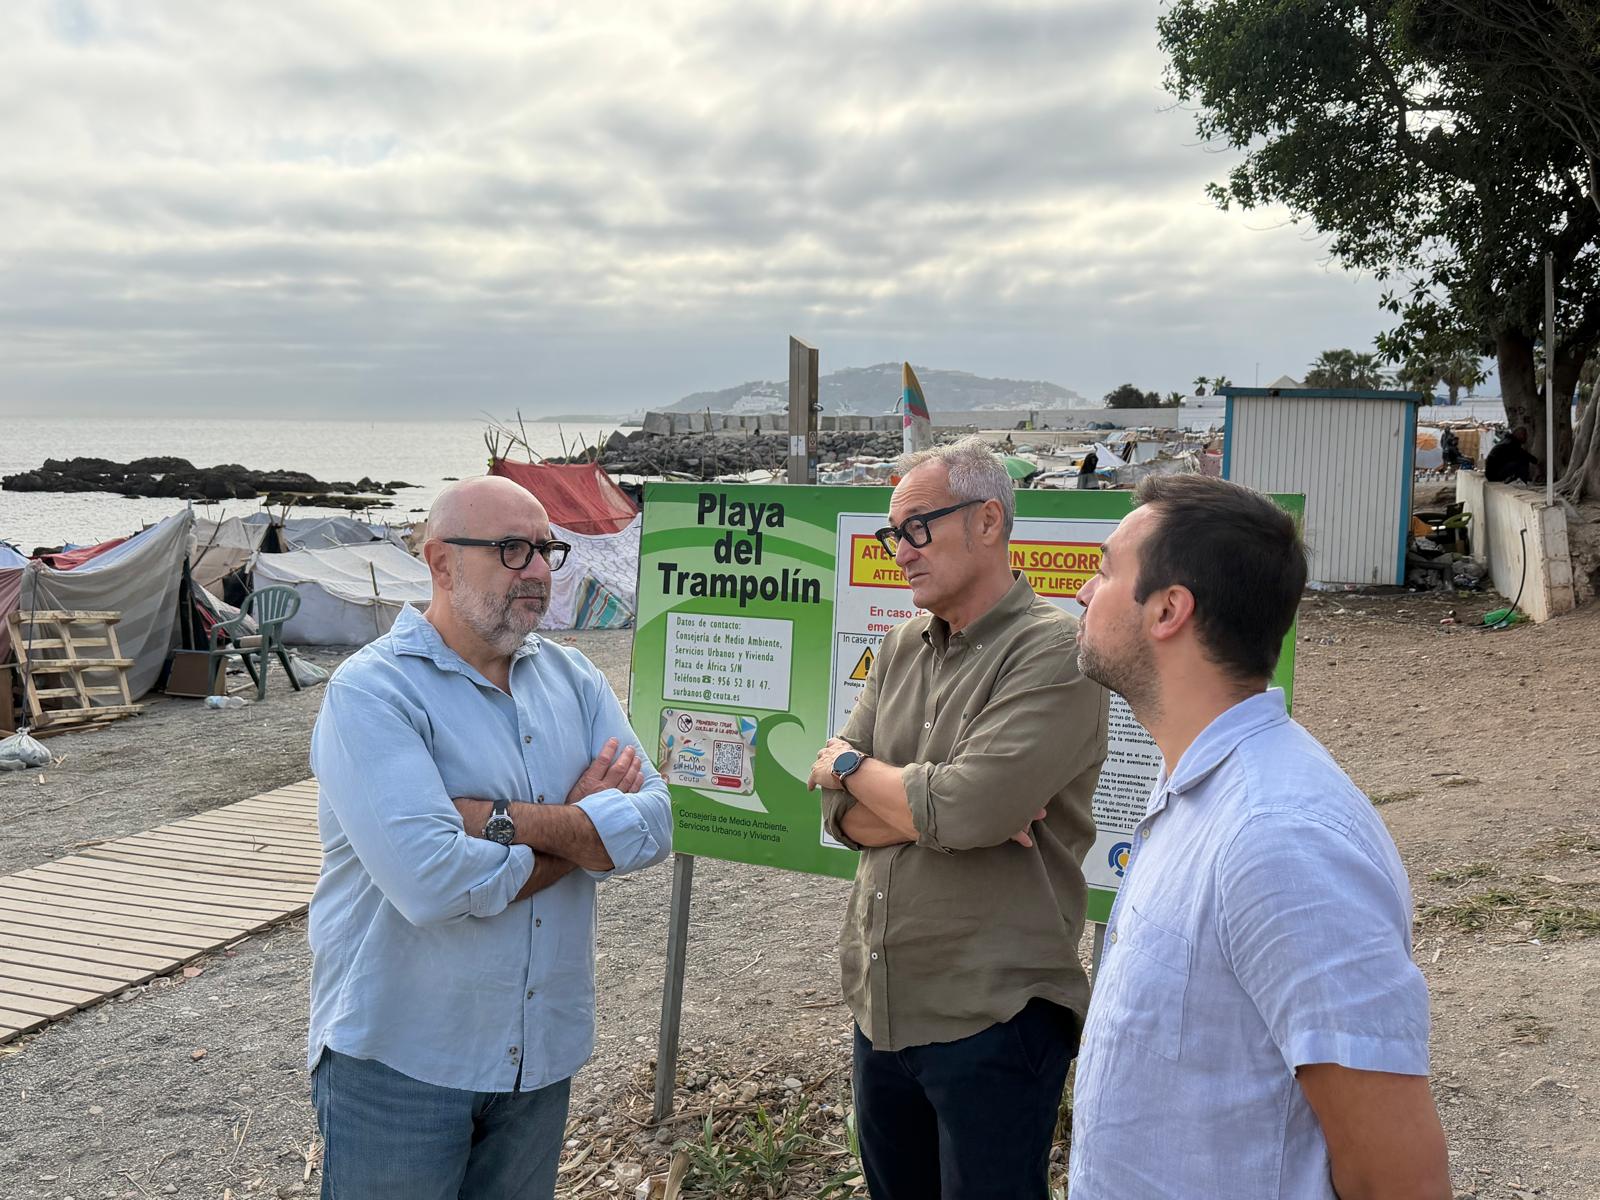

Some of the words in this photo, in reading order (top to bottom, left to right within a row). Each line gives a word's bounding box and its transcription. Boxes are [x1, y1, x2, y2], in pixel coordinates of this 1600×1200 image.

[697, 492, 785, 535] Playa
[714, 530, 763, 565] del
[1030, 551, 1102, 569] SOCORR
[657, 562, 821, 608] Trampolín
[870, 606, 884, 617] En
[886, 609, 912, 619] caso
[676, 616, 695, 627] Datos
[698, 617, 706, 627] de
[713, 633, 721, 643] de
[724, 634, 745, 645] Medio
[843, 635, 850, 643] In
[851, 637, 868, 645] case
[869, 637, 877, 645] of
[675, 645, 704, 656] Servicios
[707, 647, 735, 659] Urbanos
[738, 652, 743, 662] y
[745, 651, 775, 662] Vivienda
[674, 658, 692, 669] Plaza
[695, 660, 704, 670] de
[717, 676, 731, 687] 956
[734, 677, 743, 688] 52
[679, 754, 700, 763] PLAYA
[678, 774, 700, 783] Ceuta
[718, 815, 728, 824] de
[729, 816, 751, 827] Medio
[678, 820, 710, 832] Servicios
[711, 825, 742, 837] Urbanos
[749, 830, 781, 843] Vivienda
